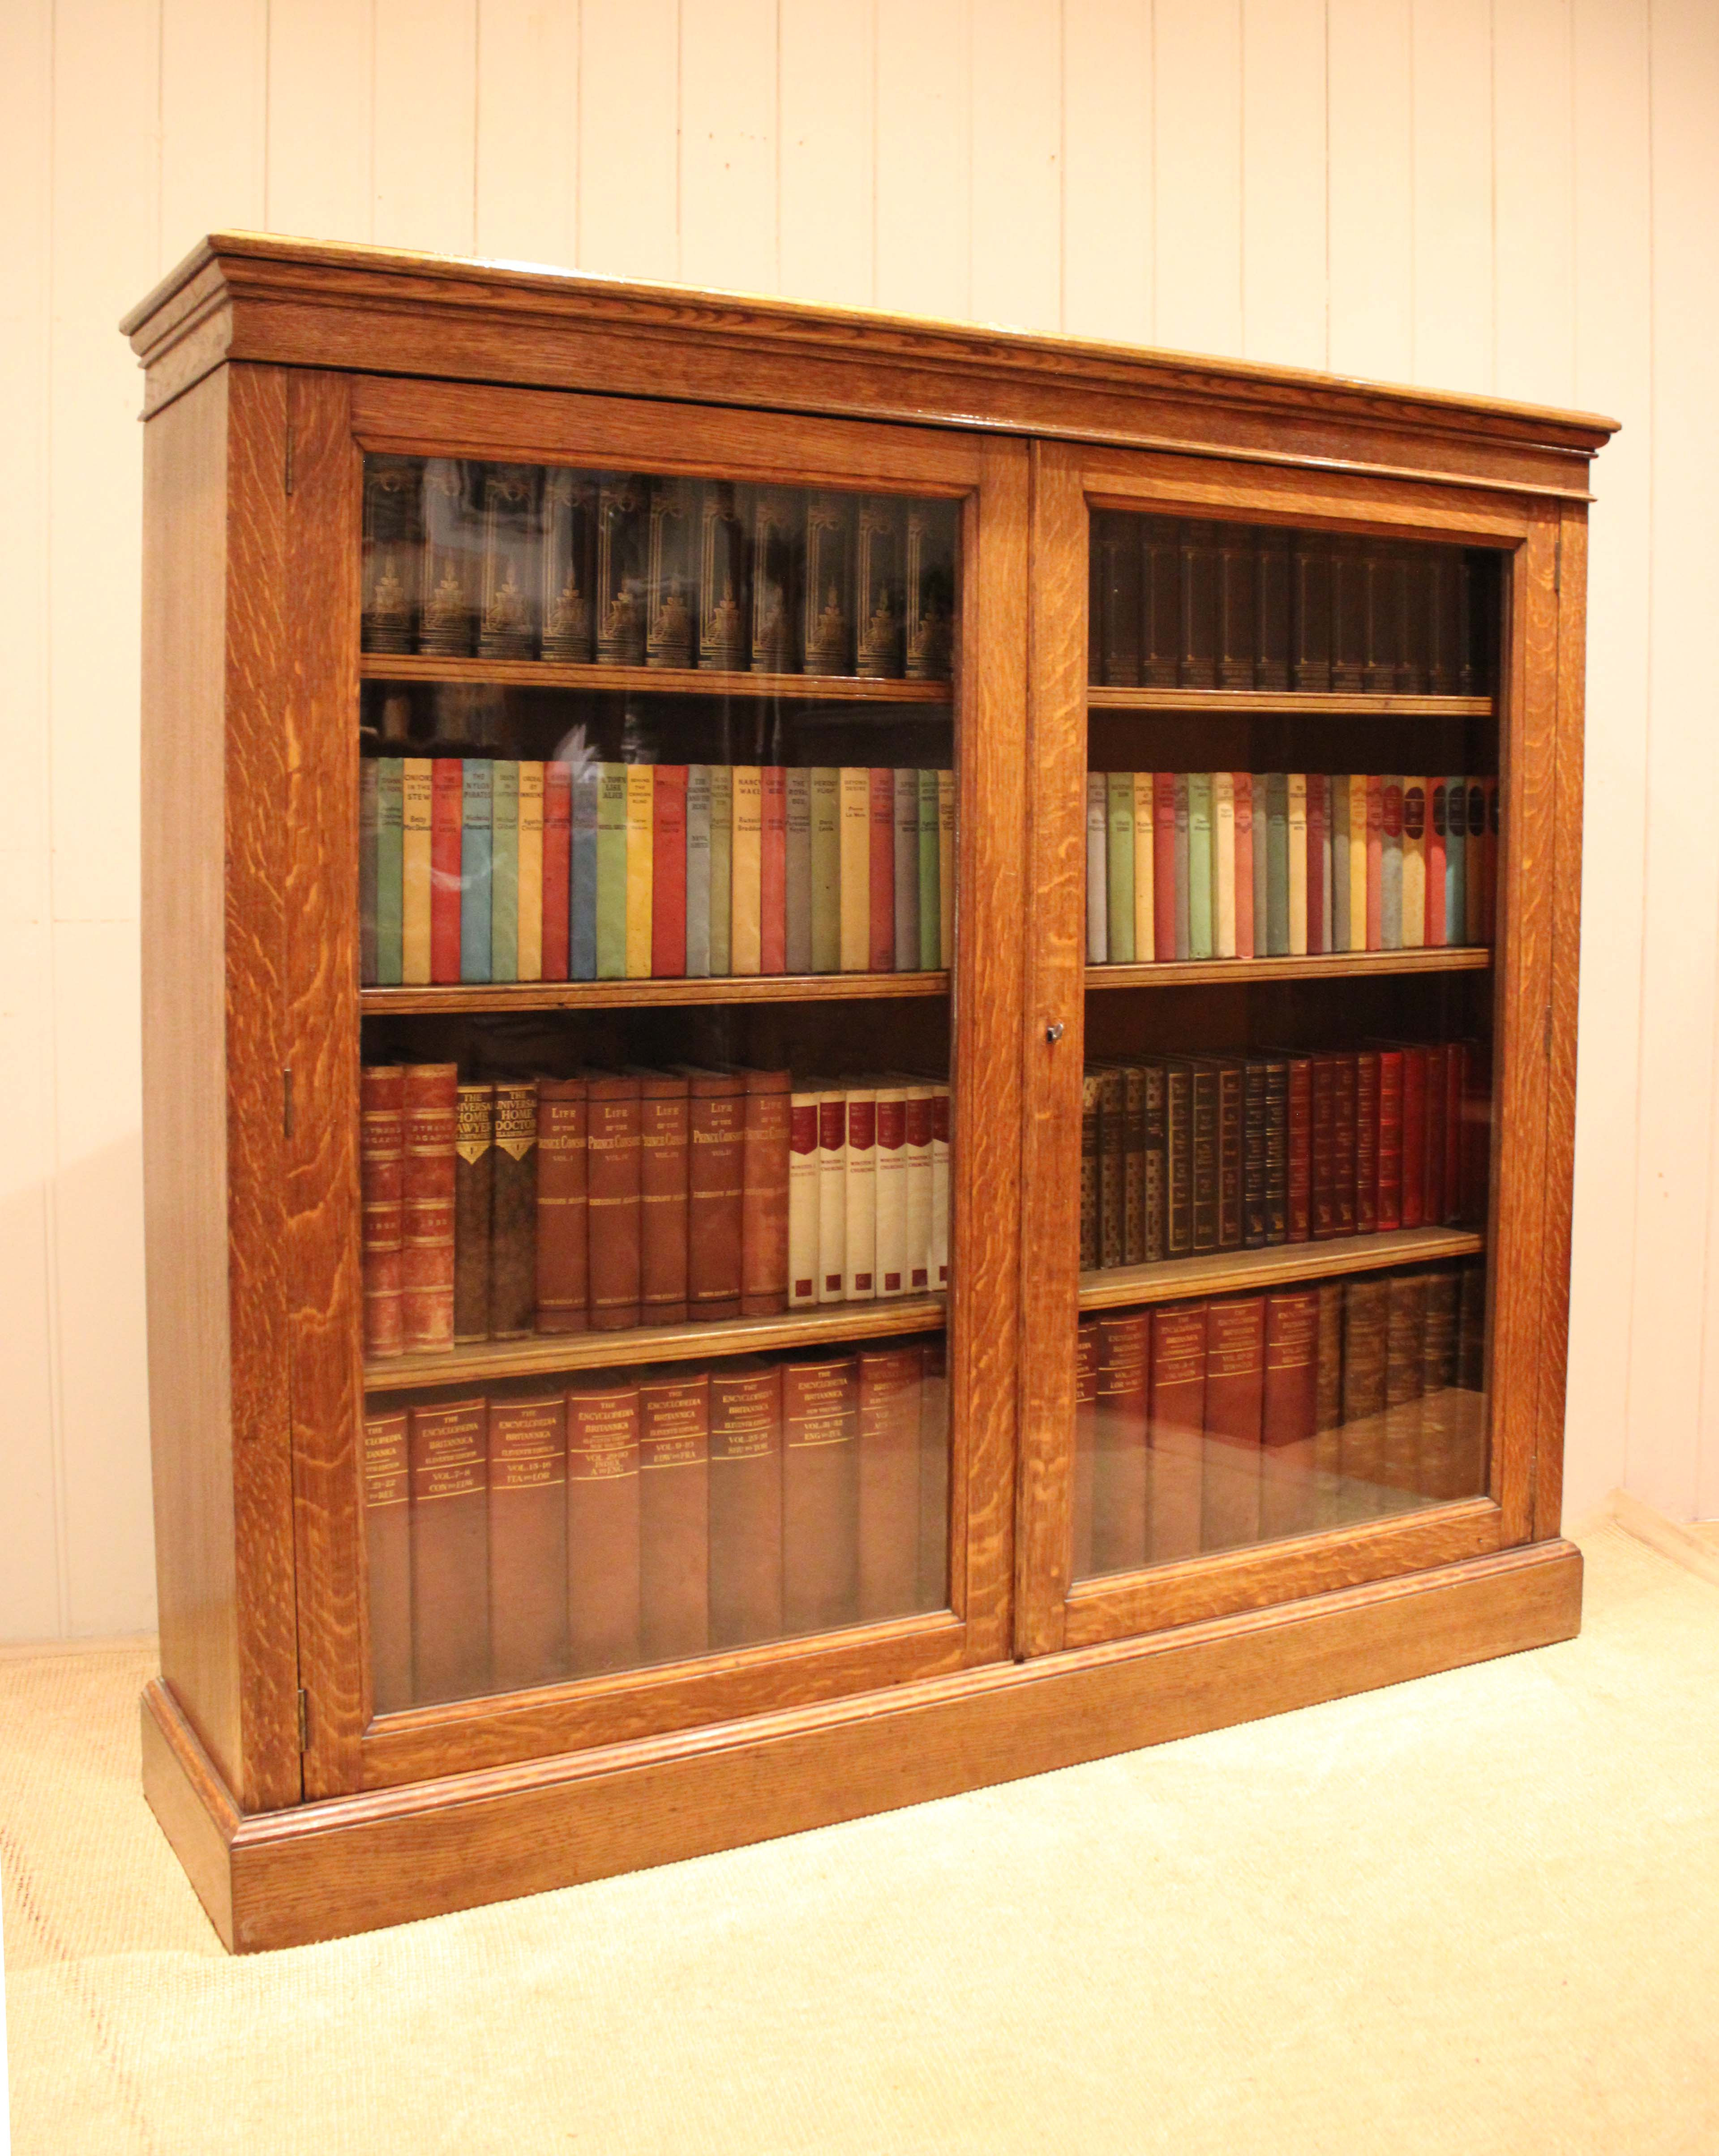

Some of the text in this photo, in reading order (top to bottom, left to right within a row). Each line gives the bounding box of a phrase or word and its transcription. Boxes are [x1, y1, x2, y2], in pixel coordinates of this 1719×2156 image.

[464, 1093, 483, 1102] THE
[509, 1091, 527, 1100] THE
[501, 1108, 532, 1120] HOME
